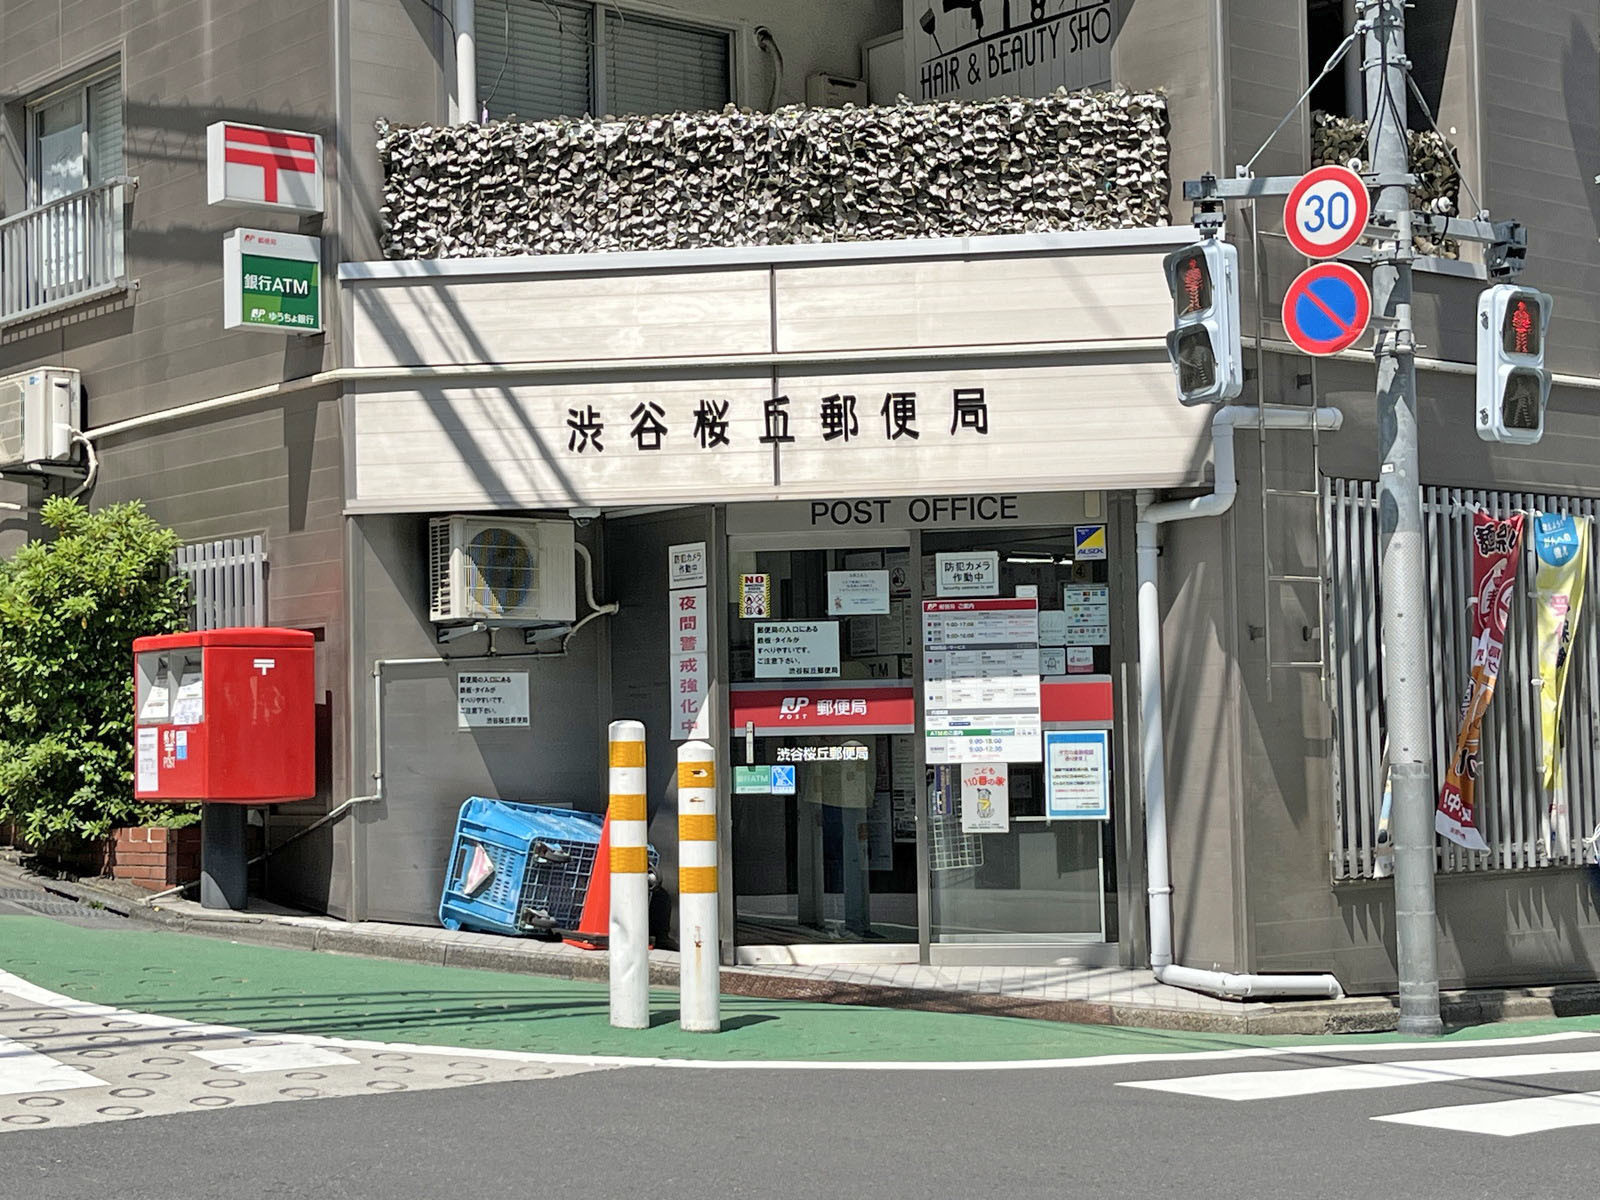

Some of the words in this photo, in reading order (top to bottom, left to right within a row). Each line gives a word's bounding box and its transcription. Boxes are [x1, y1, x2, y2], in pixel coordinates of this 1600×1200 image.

[920, 57, 960, 100] HAIR
[968, 53, 981, 85] &
[987, 21, 1060, 79] BEAUTY
[1069, 7, 1111, 53] SHO
[1304, 191, 1349, 233] 30
[244, 274, 309, 295] 銀行ATM
[268, 311, 314, 324] ゆうちょ銀行
[566, 387, 988, 453] 渋谷桜丘郵便局
[810, 499, 891, 525] POST
[908, 495, 1019, 523] OFFICE
[674, 552, 702, 564] 防犯カメラ
[1077, 547, 1104, 555] ALSOK
[944, 561, 991, 572] 防犯カメラ
[952, 572, 984, 583] 作動中
[757, 625, 819, 634] 郵便局の入口にある
[679, 595, 699, 735] 夜間警戒強化中
[789, 666, 838, 675] 渋谷桜丘郵便局
[816, 699, 867, 716] 郵便局
[776, 746, 869, 762] 渋谷桜丘郵便局
[974, 767, 996, 775] こども
